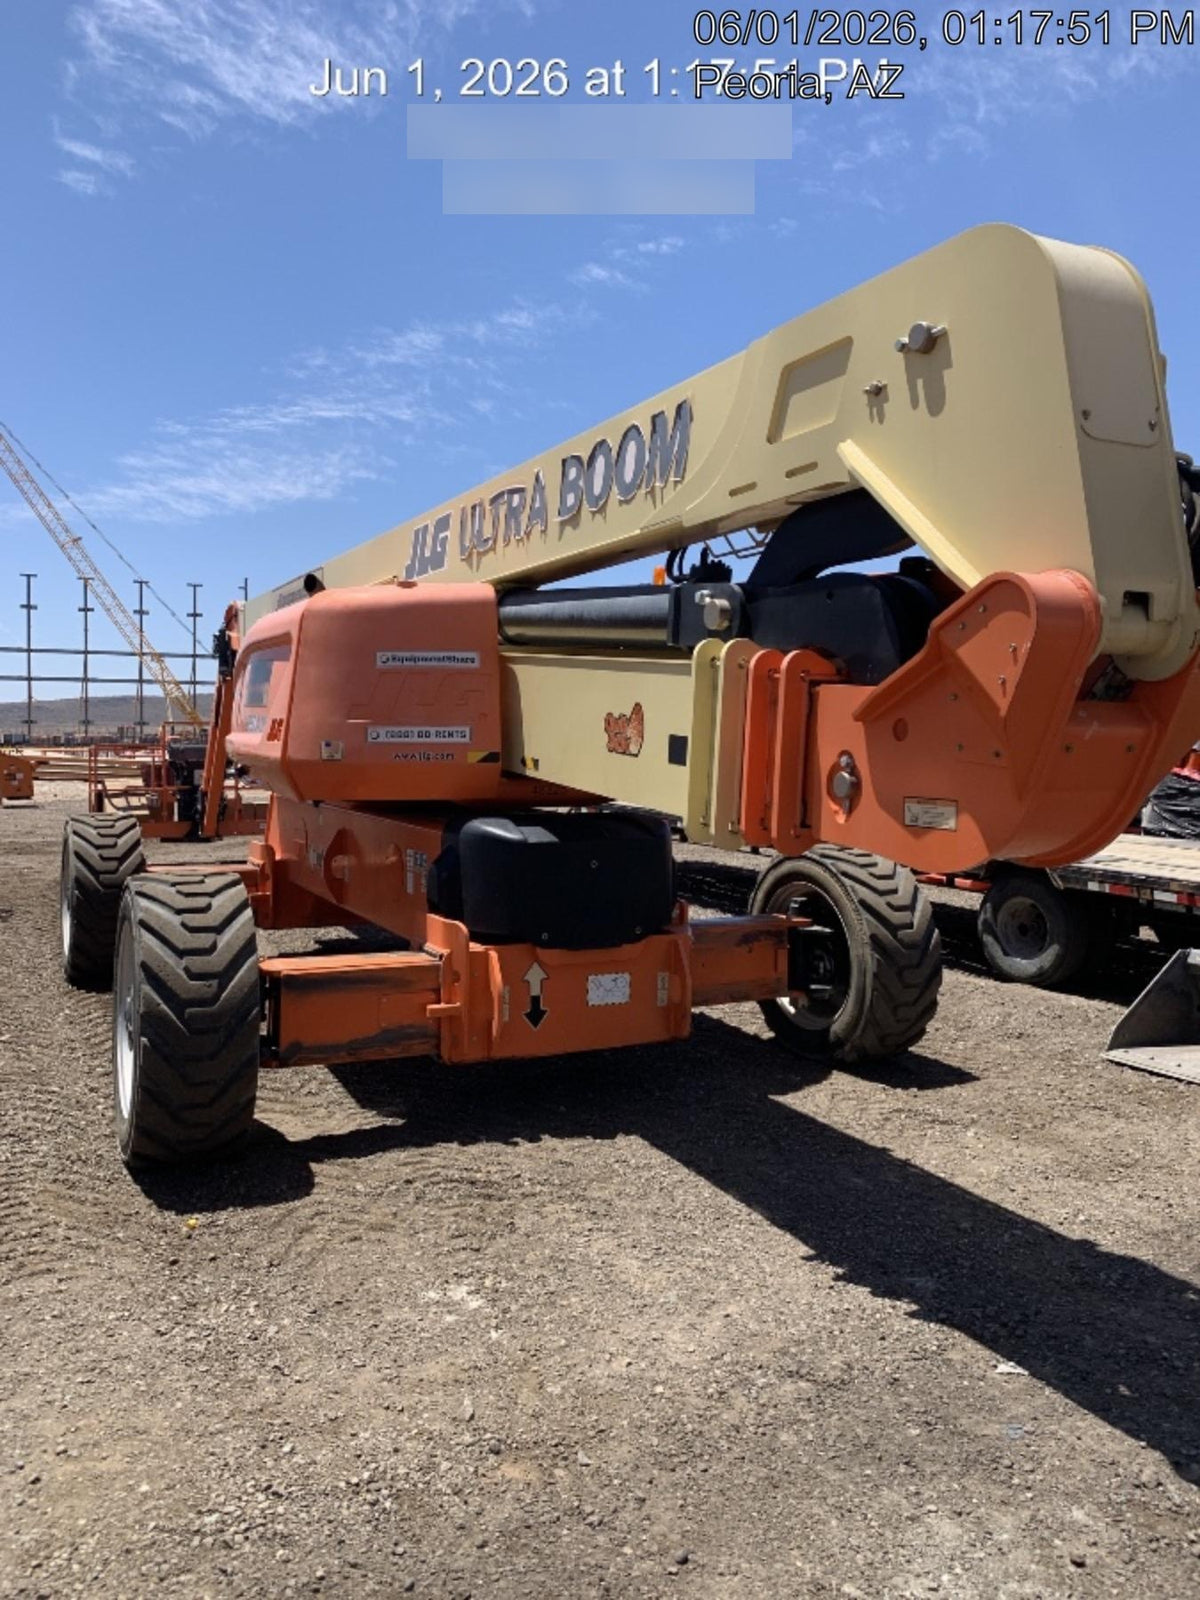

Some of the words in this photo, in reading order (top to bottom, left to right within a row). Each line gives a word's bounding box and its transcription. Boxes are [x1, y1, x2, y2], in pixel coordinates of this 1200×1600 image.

[404, 512, 453, 580] JLG
[459, 468, 548, 560] ULTRA
[556, 399, 693, 522] BOOM
